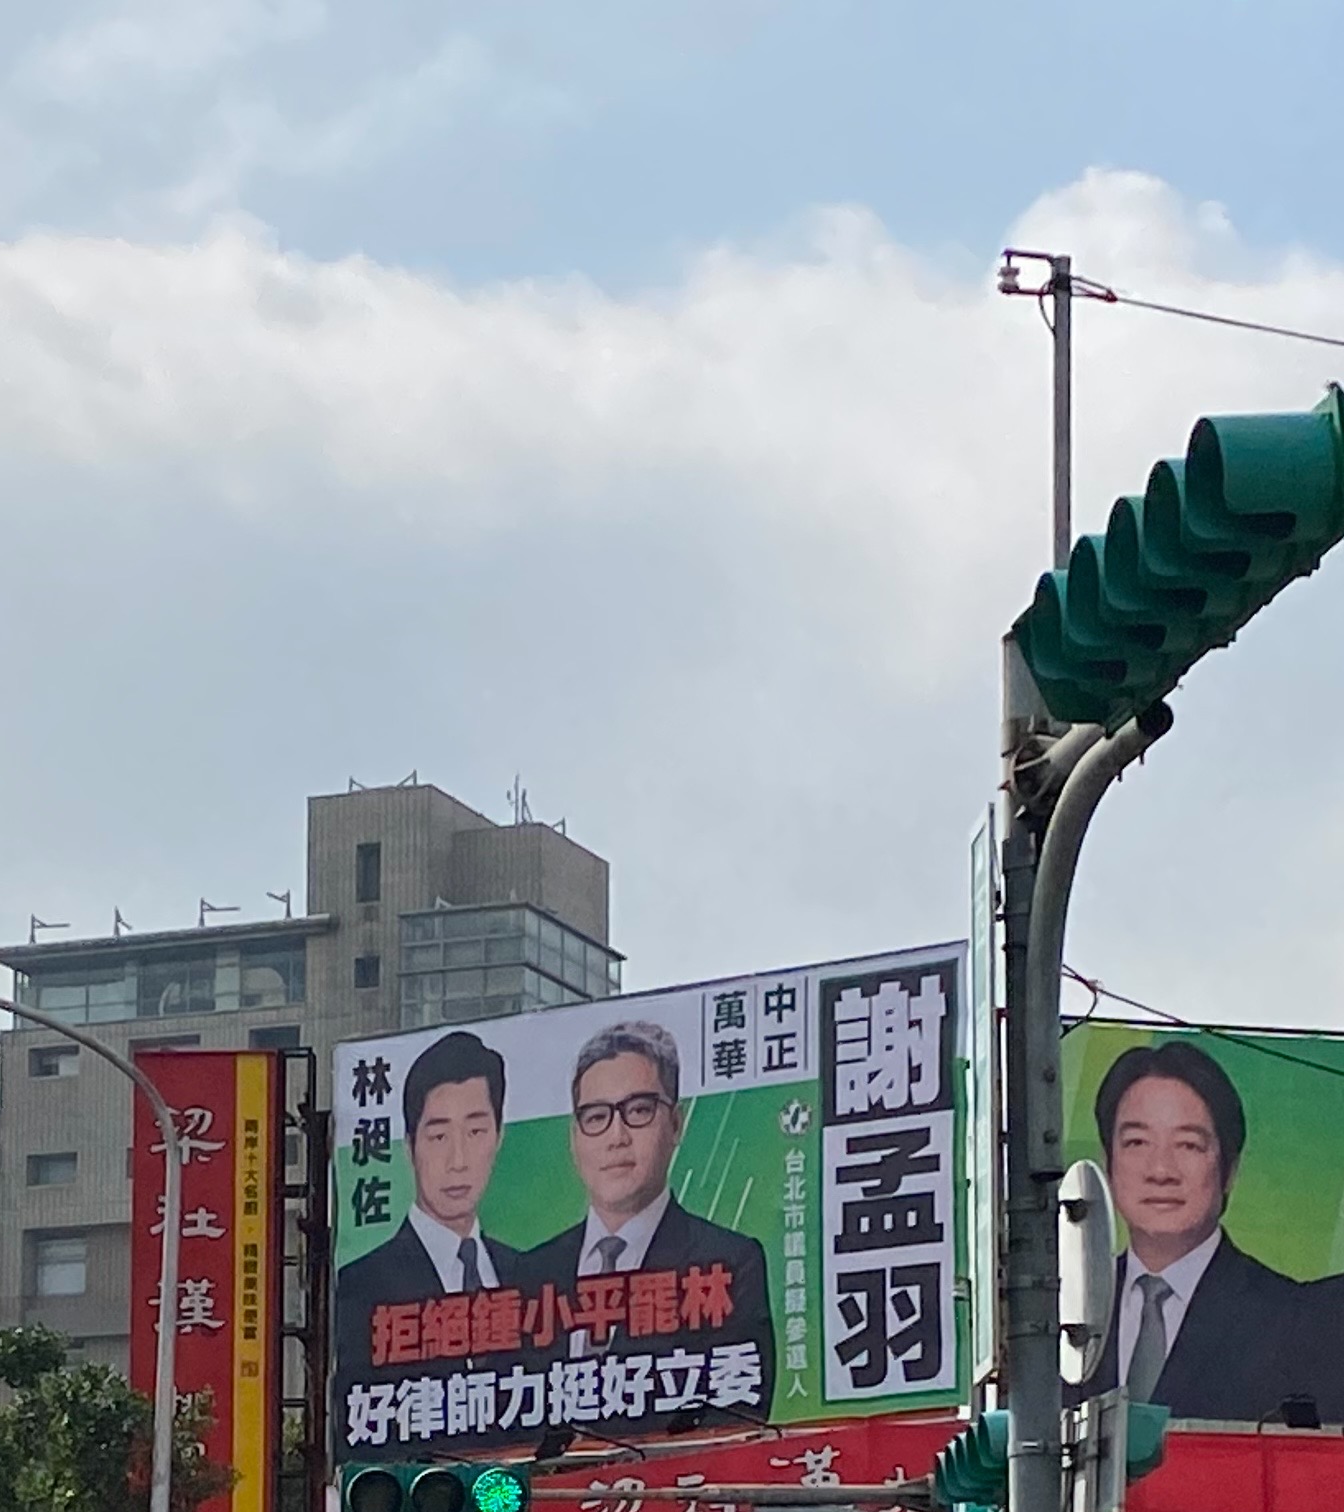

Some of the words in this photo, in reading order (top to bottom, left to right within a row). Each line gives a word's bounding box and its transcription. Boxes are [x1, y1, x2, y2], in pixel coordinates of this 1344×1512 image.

[711, 989, 748, 1081] 萬華
[762, 982, 799, 1073] 中正
[351, 1057, 393, 1228] 林昶佐
[832, 974, 948, 1390] 謝孟羽
[346, 1340, 763, 1447] 好律師力挺好立委
